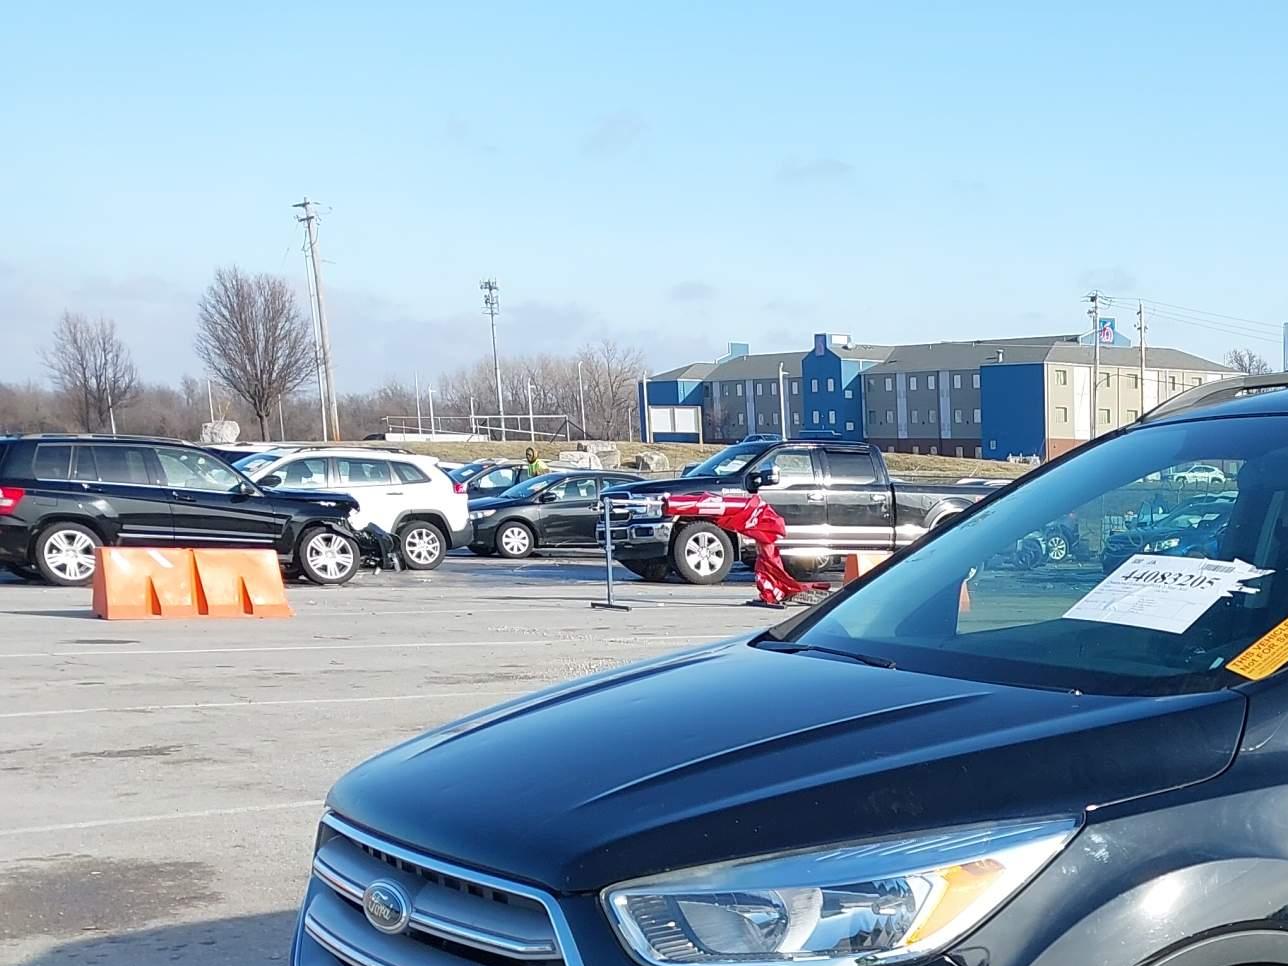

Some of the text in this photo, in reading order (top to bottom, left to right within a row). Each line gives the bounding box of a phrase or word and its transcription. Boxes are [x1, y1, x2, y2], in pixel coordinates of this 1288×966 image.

[1121, 568, 1221, 591] 44083205
[1231, 649, 1255, 668] THIS
[1258, 641, 1279, 659] FOR
